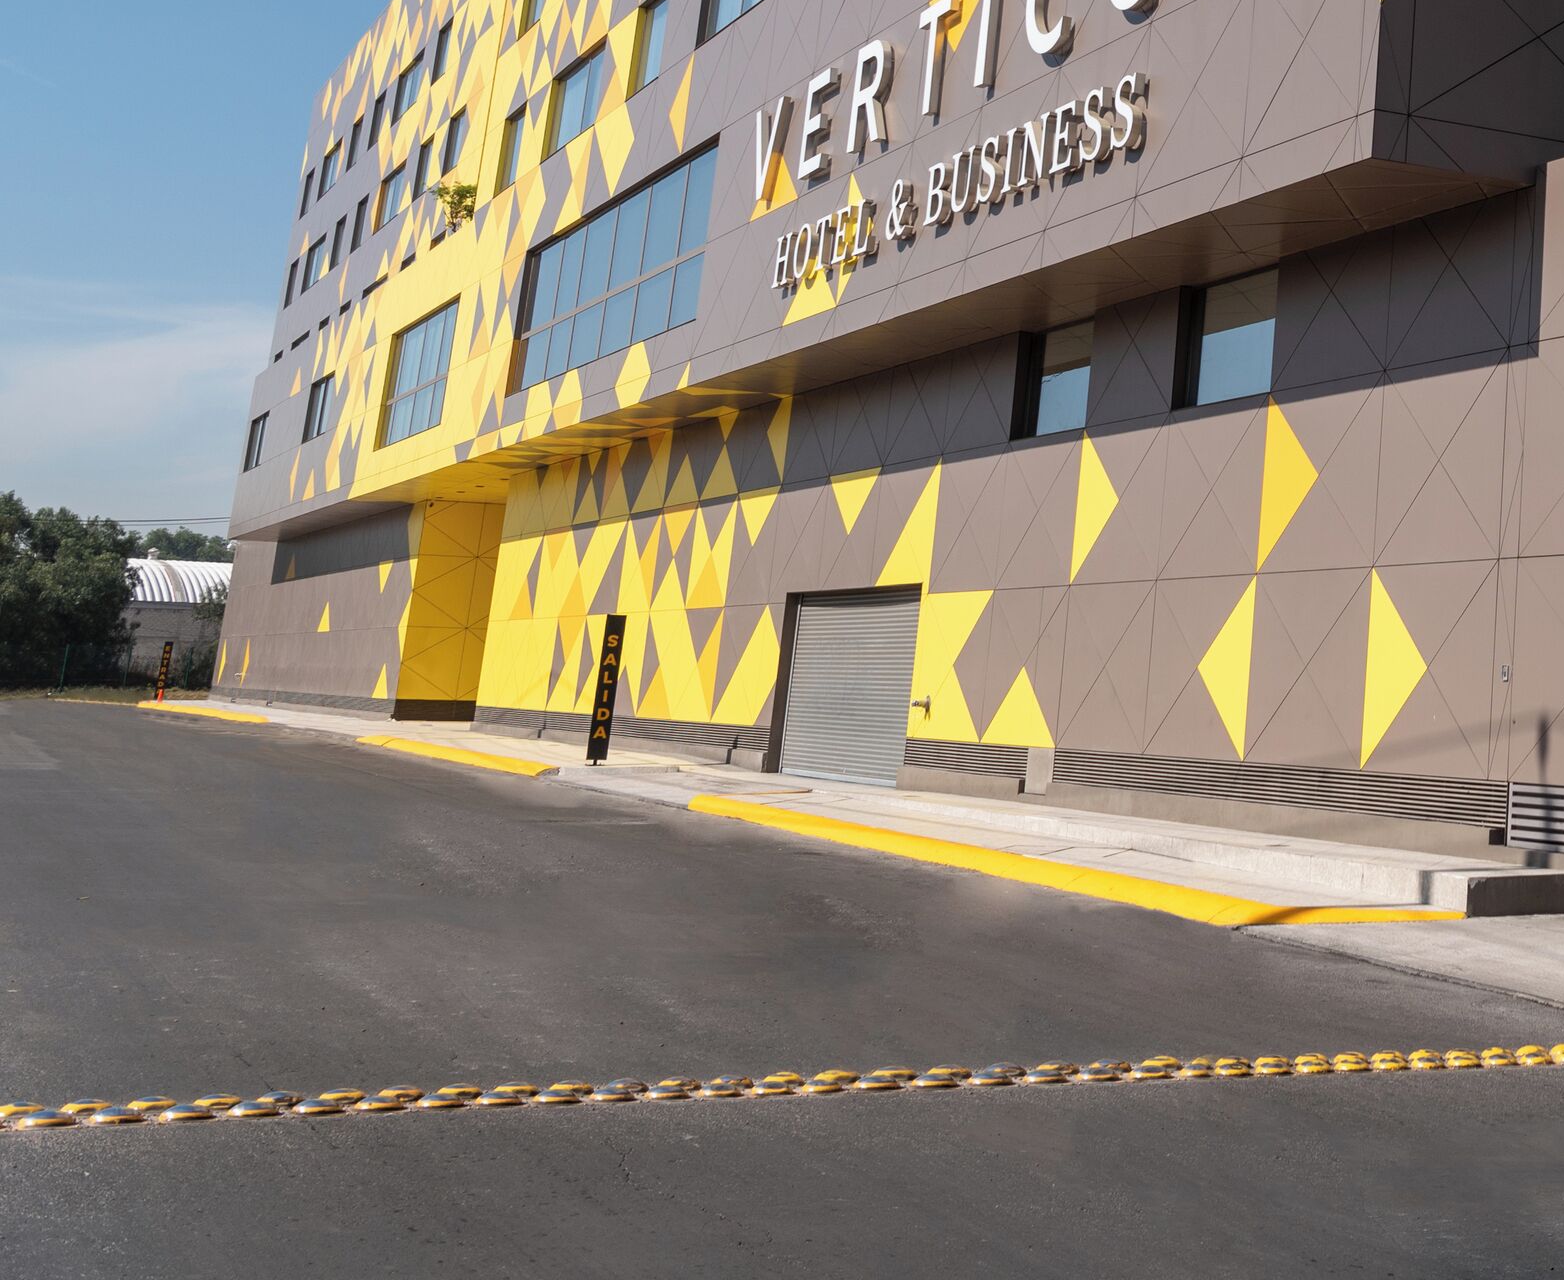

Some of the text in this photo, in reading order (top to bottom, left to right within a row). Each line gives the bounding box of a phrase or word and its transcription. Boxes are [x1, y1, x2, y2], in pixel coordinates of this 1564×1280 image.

[771, 71, 1149, 292] HOTEL & BUSINESS
[593, 634, 619, 739] SALIDA
